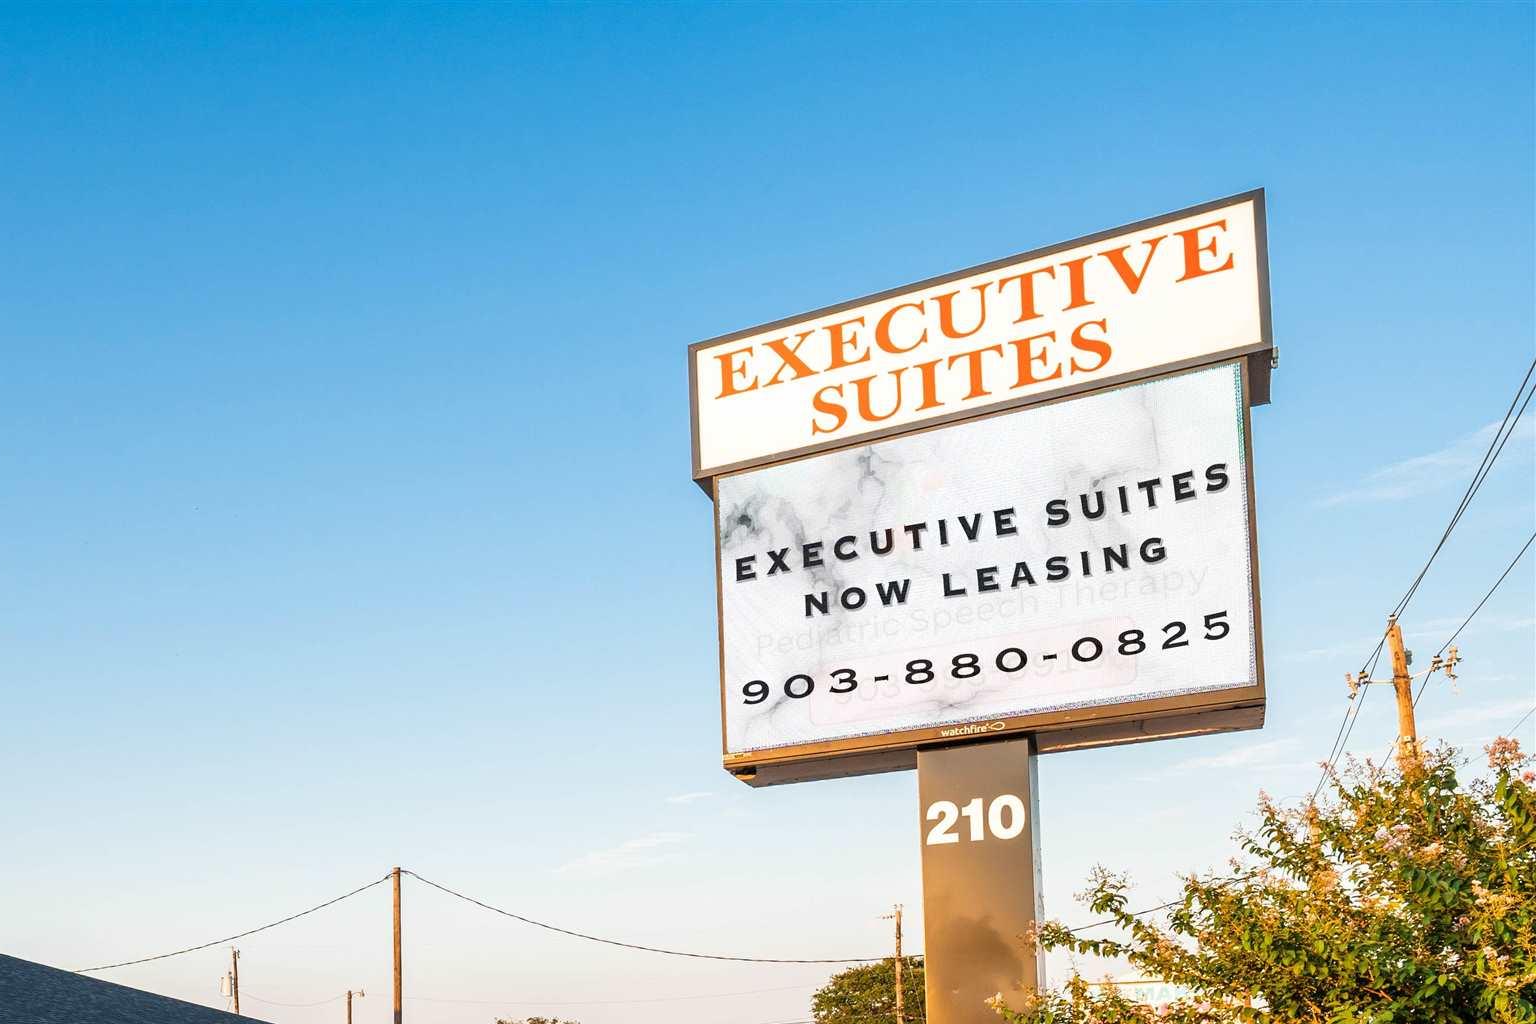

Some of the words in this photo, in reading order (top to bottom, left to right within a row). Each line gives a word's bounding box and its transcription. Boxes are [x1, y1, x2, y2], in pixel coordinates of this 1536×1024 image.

[714, 218, 1235, 400] EXECUTIVE
[810, 317, 1113, 437] SUITES
[734, 506, 1019, 583] EXECUTIVE
[1045, 462, 1231, 528] SUITES
[756, 610, 903, 658] Pediatric
[910, 587, 1039, 636] Speech
[1042, 565, 1210, 610] Therapy
[803, 578, 911, 618] NOW
[942, 536, 1168, 598] LEASING
[741, 610, 1232, 706] 903-880-0825
[940, 723, 989, 737] watchfire
[926, 794, 1026, 846] 210
